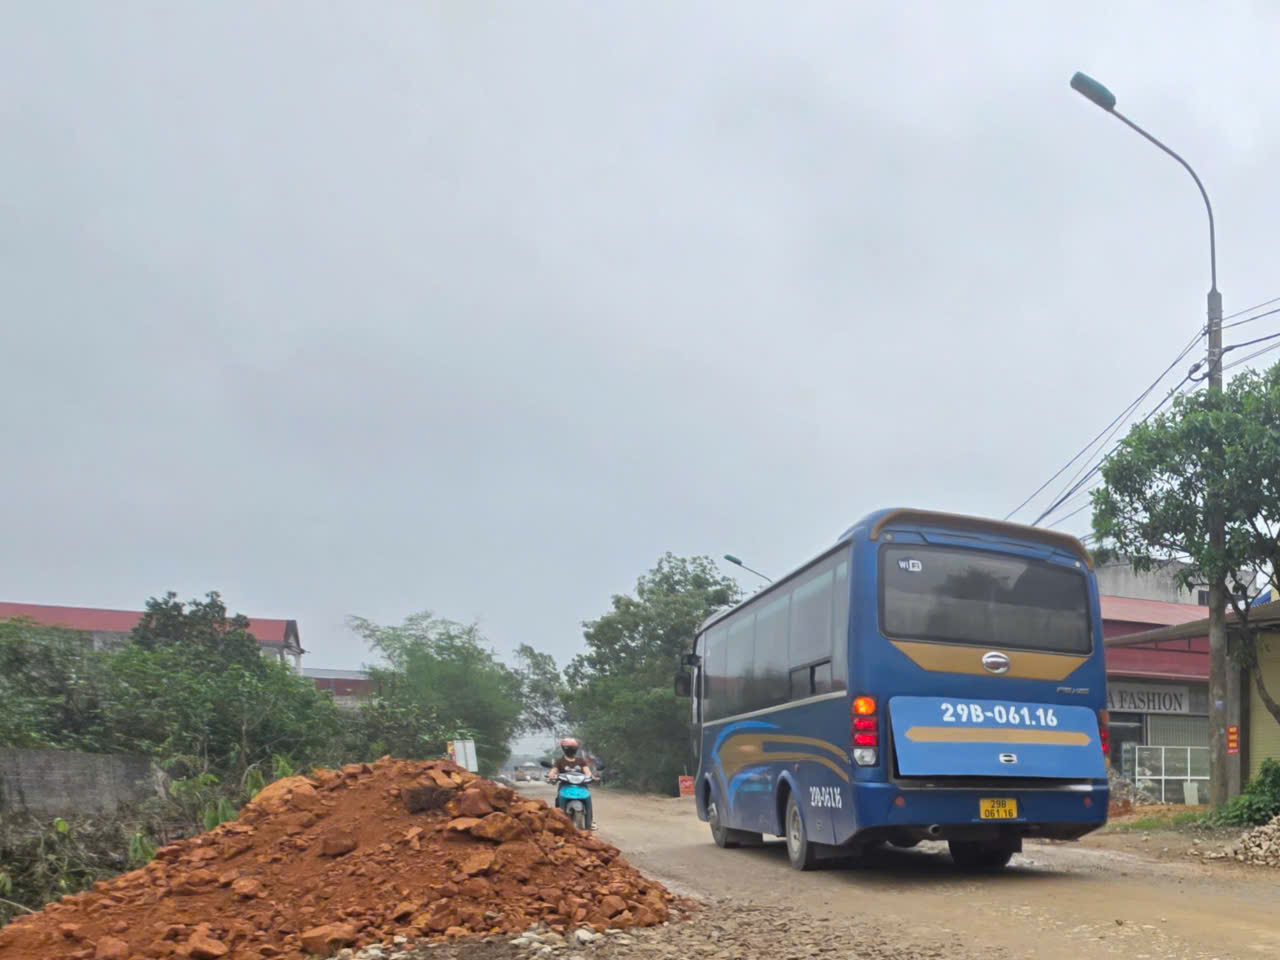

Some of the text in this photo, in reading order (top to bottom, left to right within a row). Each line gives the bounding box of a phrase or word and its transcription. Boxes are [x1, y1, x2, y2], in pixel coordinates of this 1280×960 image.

[1118, 690, 1183, 711] FASHION
[940, 702, 1059, 727] 29B-061.16
[991, 800, 1007, 809] 29B
